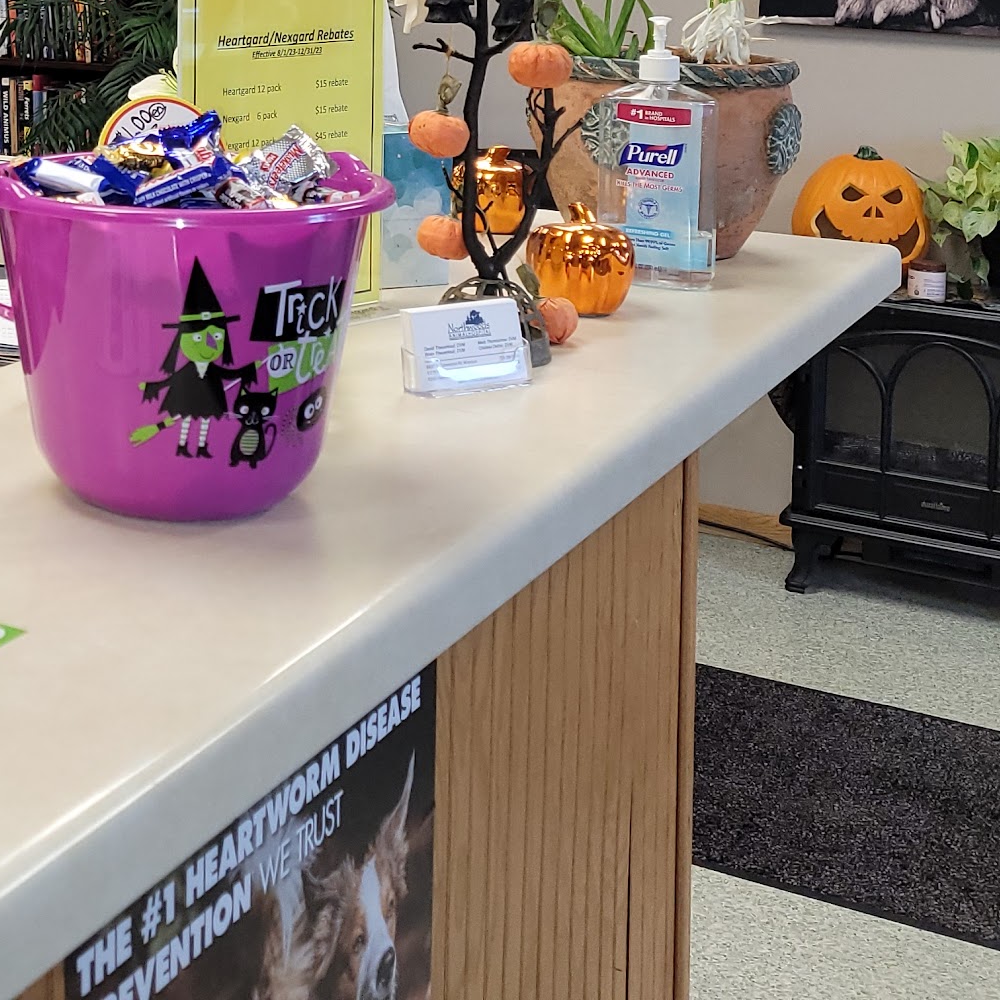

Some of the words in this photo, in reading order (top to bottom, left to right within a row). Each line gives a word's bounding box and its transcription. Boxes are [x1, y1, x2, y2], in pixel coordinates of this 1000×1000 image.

[218, 30, 315, 48] Heartgard/Nexgard
[317, 29, 354, 40] Rebates
[252, 50, 275, 58] Effective
[315, 79, 327, 88] $15
[328, 78, 348, 87] rebate
[223, 85, 255, 96] Heartgard
[257, 85, 265, 93] 12
[267, 83, 281, 93] pack
[315, 105, 326, 115] $15
[328, 104, 348, 113] rebate
[630, 108, 643, 119] #1
[223, 113, 250, 124] Nexgard
[257, 111, 261, 120] 6
[263, 110, 277, 121] pack
[315, 132, 326, 141] $45
[328, 130, 347, 139] rebate
[226, 141, 249, 151] exgard
[252, 139, 259, 147] 12
[627, 144, 678, 165] Purell
[626, 167, 674, 179] ADVANCED
[270, 353, 294, 371] OR
[76, 916, 132, 998] THE
[141, 881, 175, 944] #1
[186, 743, 341, 909] HEARTWORM
[345, 675, 421, 769] DISEASE
[259, 836, 292, 895] WE
[297, 789, 344, 862] TRUST
